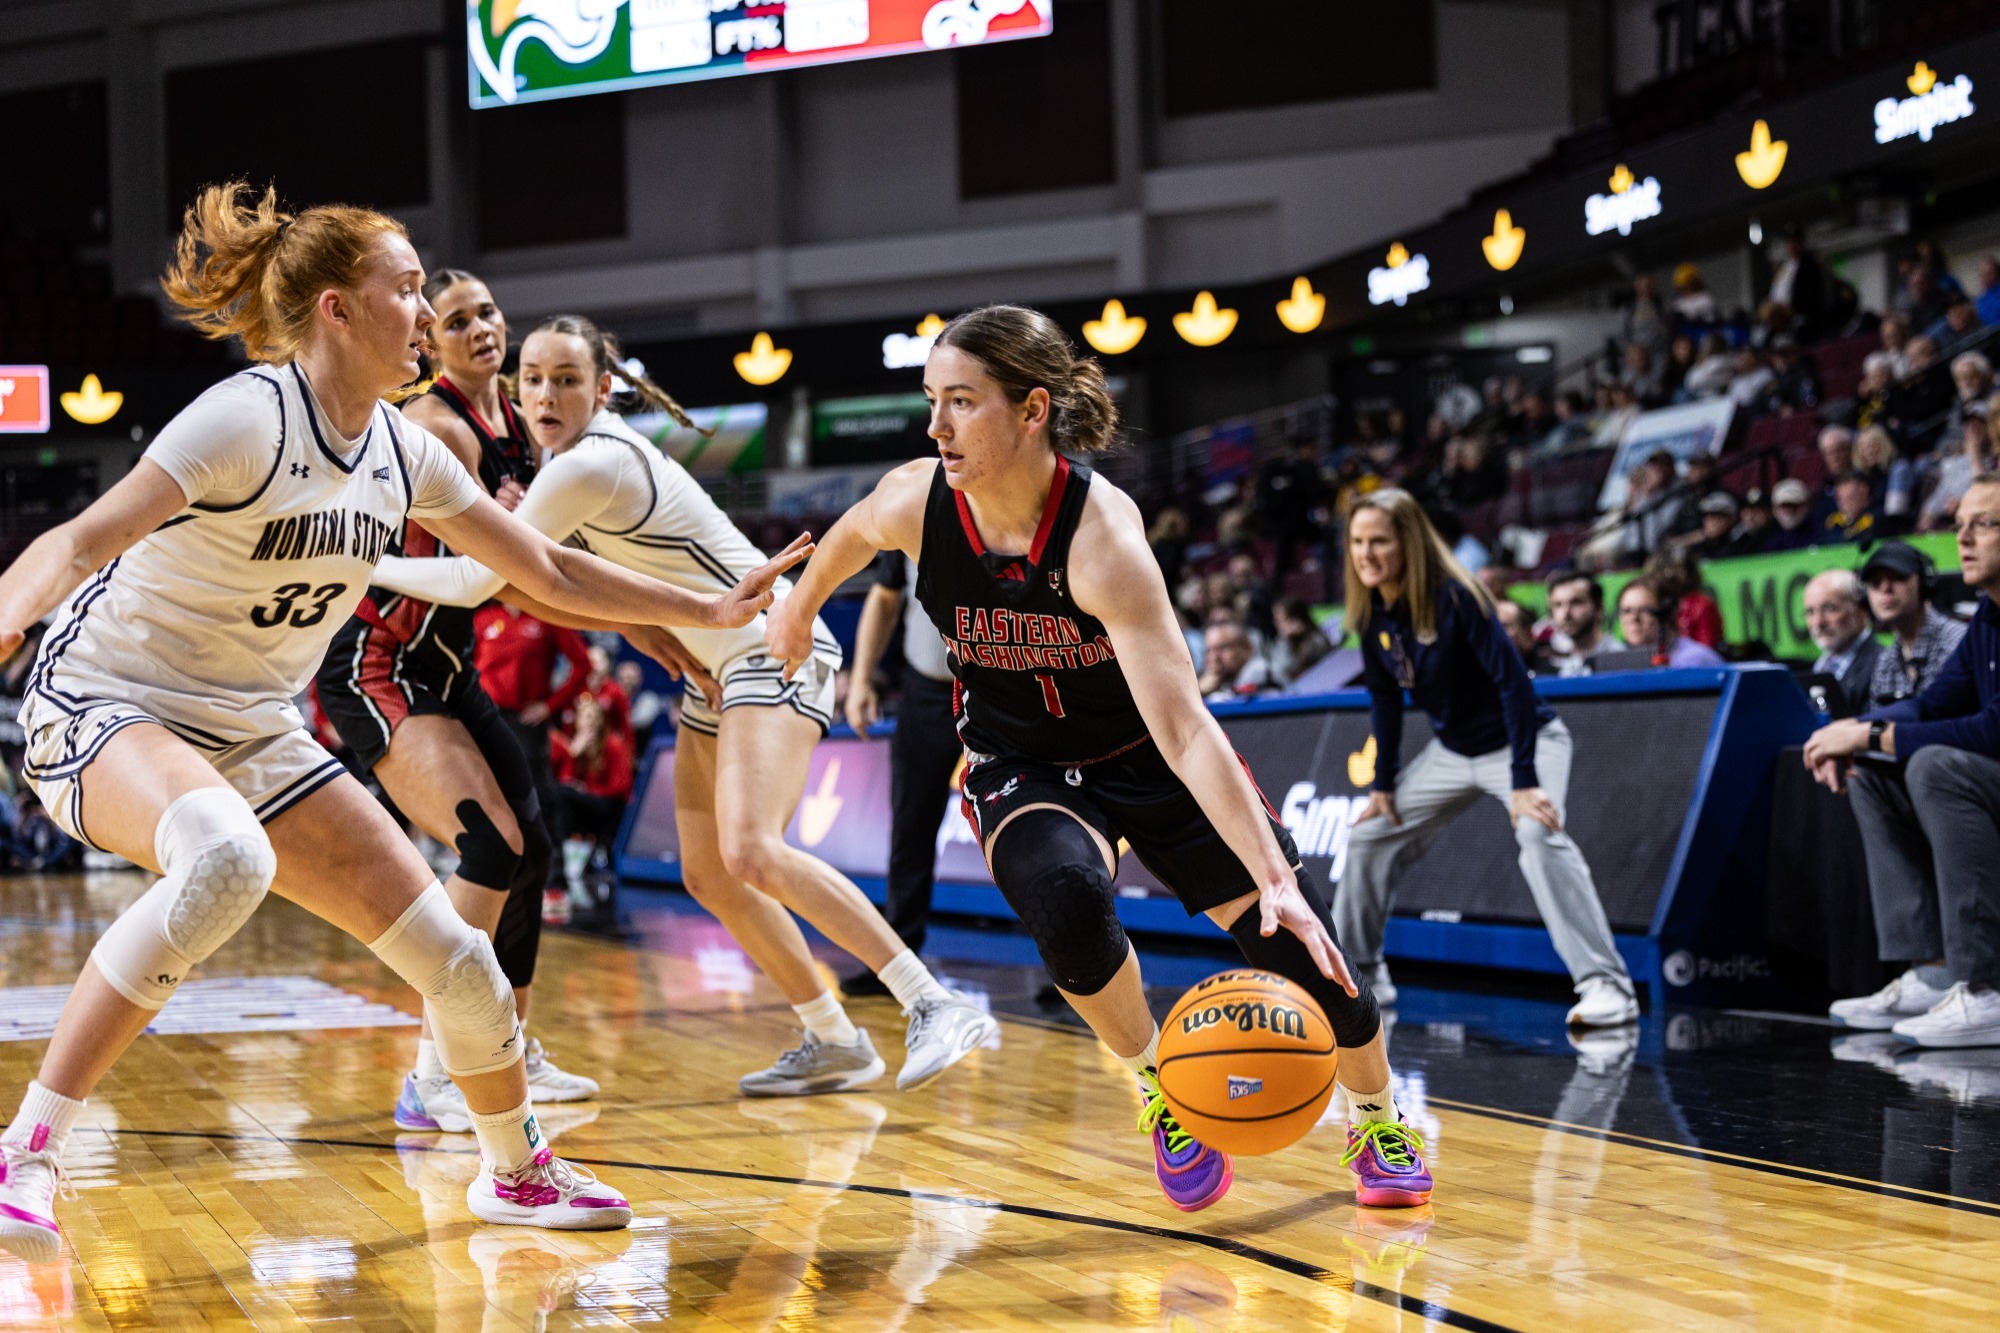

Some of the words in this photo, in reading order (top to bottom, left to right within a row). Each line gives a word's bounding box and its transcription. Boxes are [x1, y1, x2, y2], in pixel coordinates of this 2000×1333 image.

[1874, 74, 1975, 144] Simplot
[250, 508, 346, 561] MONTANA
[251, 583, 347, 628] 33
[955, 606, 1082, 646] EASTERN
[942, 633, 1116, 671] WASHINGTON
[1035, 673, 1066, 718] 1
[1182, 1002, 1308, 1041] Wilson
[1230, 1083, 1249, 1100] SKY
